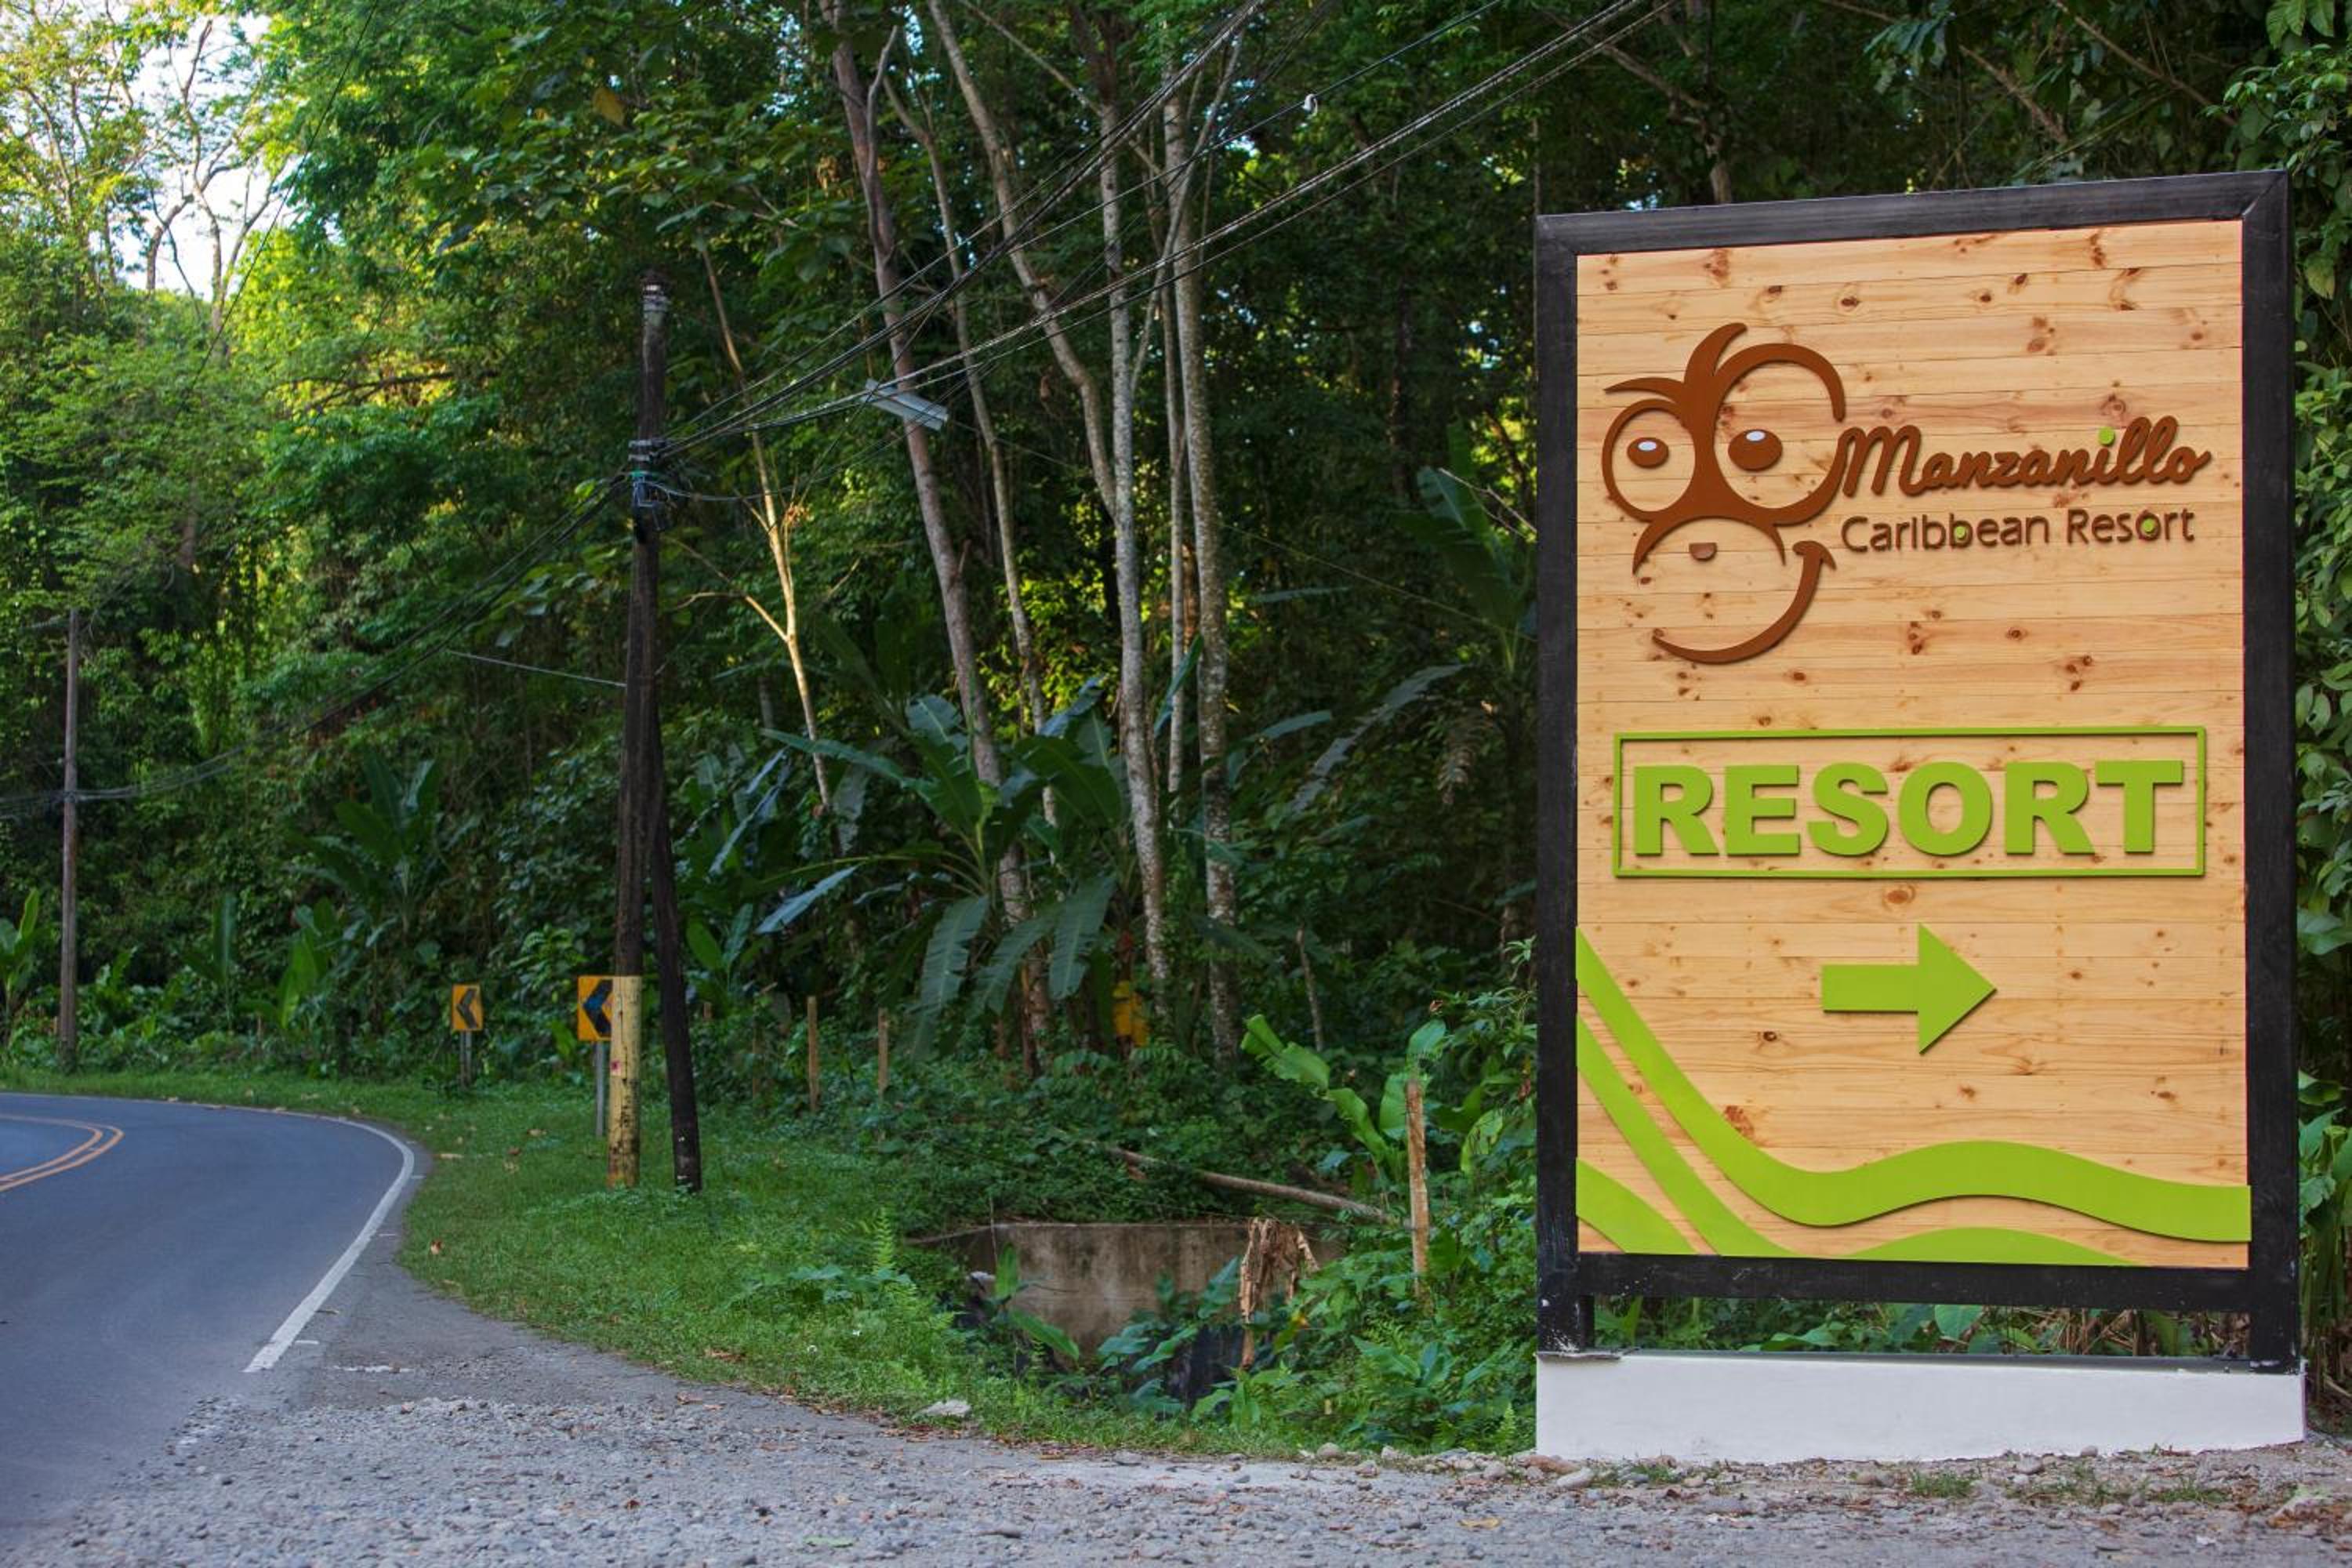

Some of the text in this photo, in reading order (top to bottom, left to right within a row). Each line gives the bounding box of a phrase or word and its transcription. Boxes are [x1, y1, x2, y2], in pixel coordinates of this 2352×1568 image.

[1836, 415, 2212, 497] Manzanillo
[1840, 507, 2196, 554] Caribbean Resort
[1633, 759, 2184, 856] RESORT
